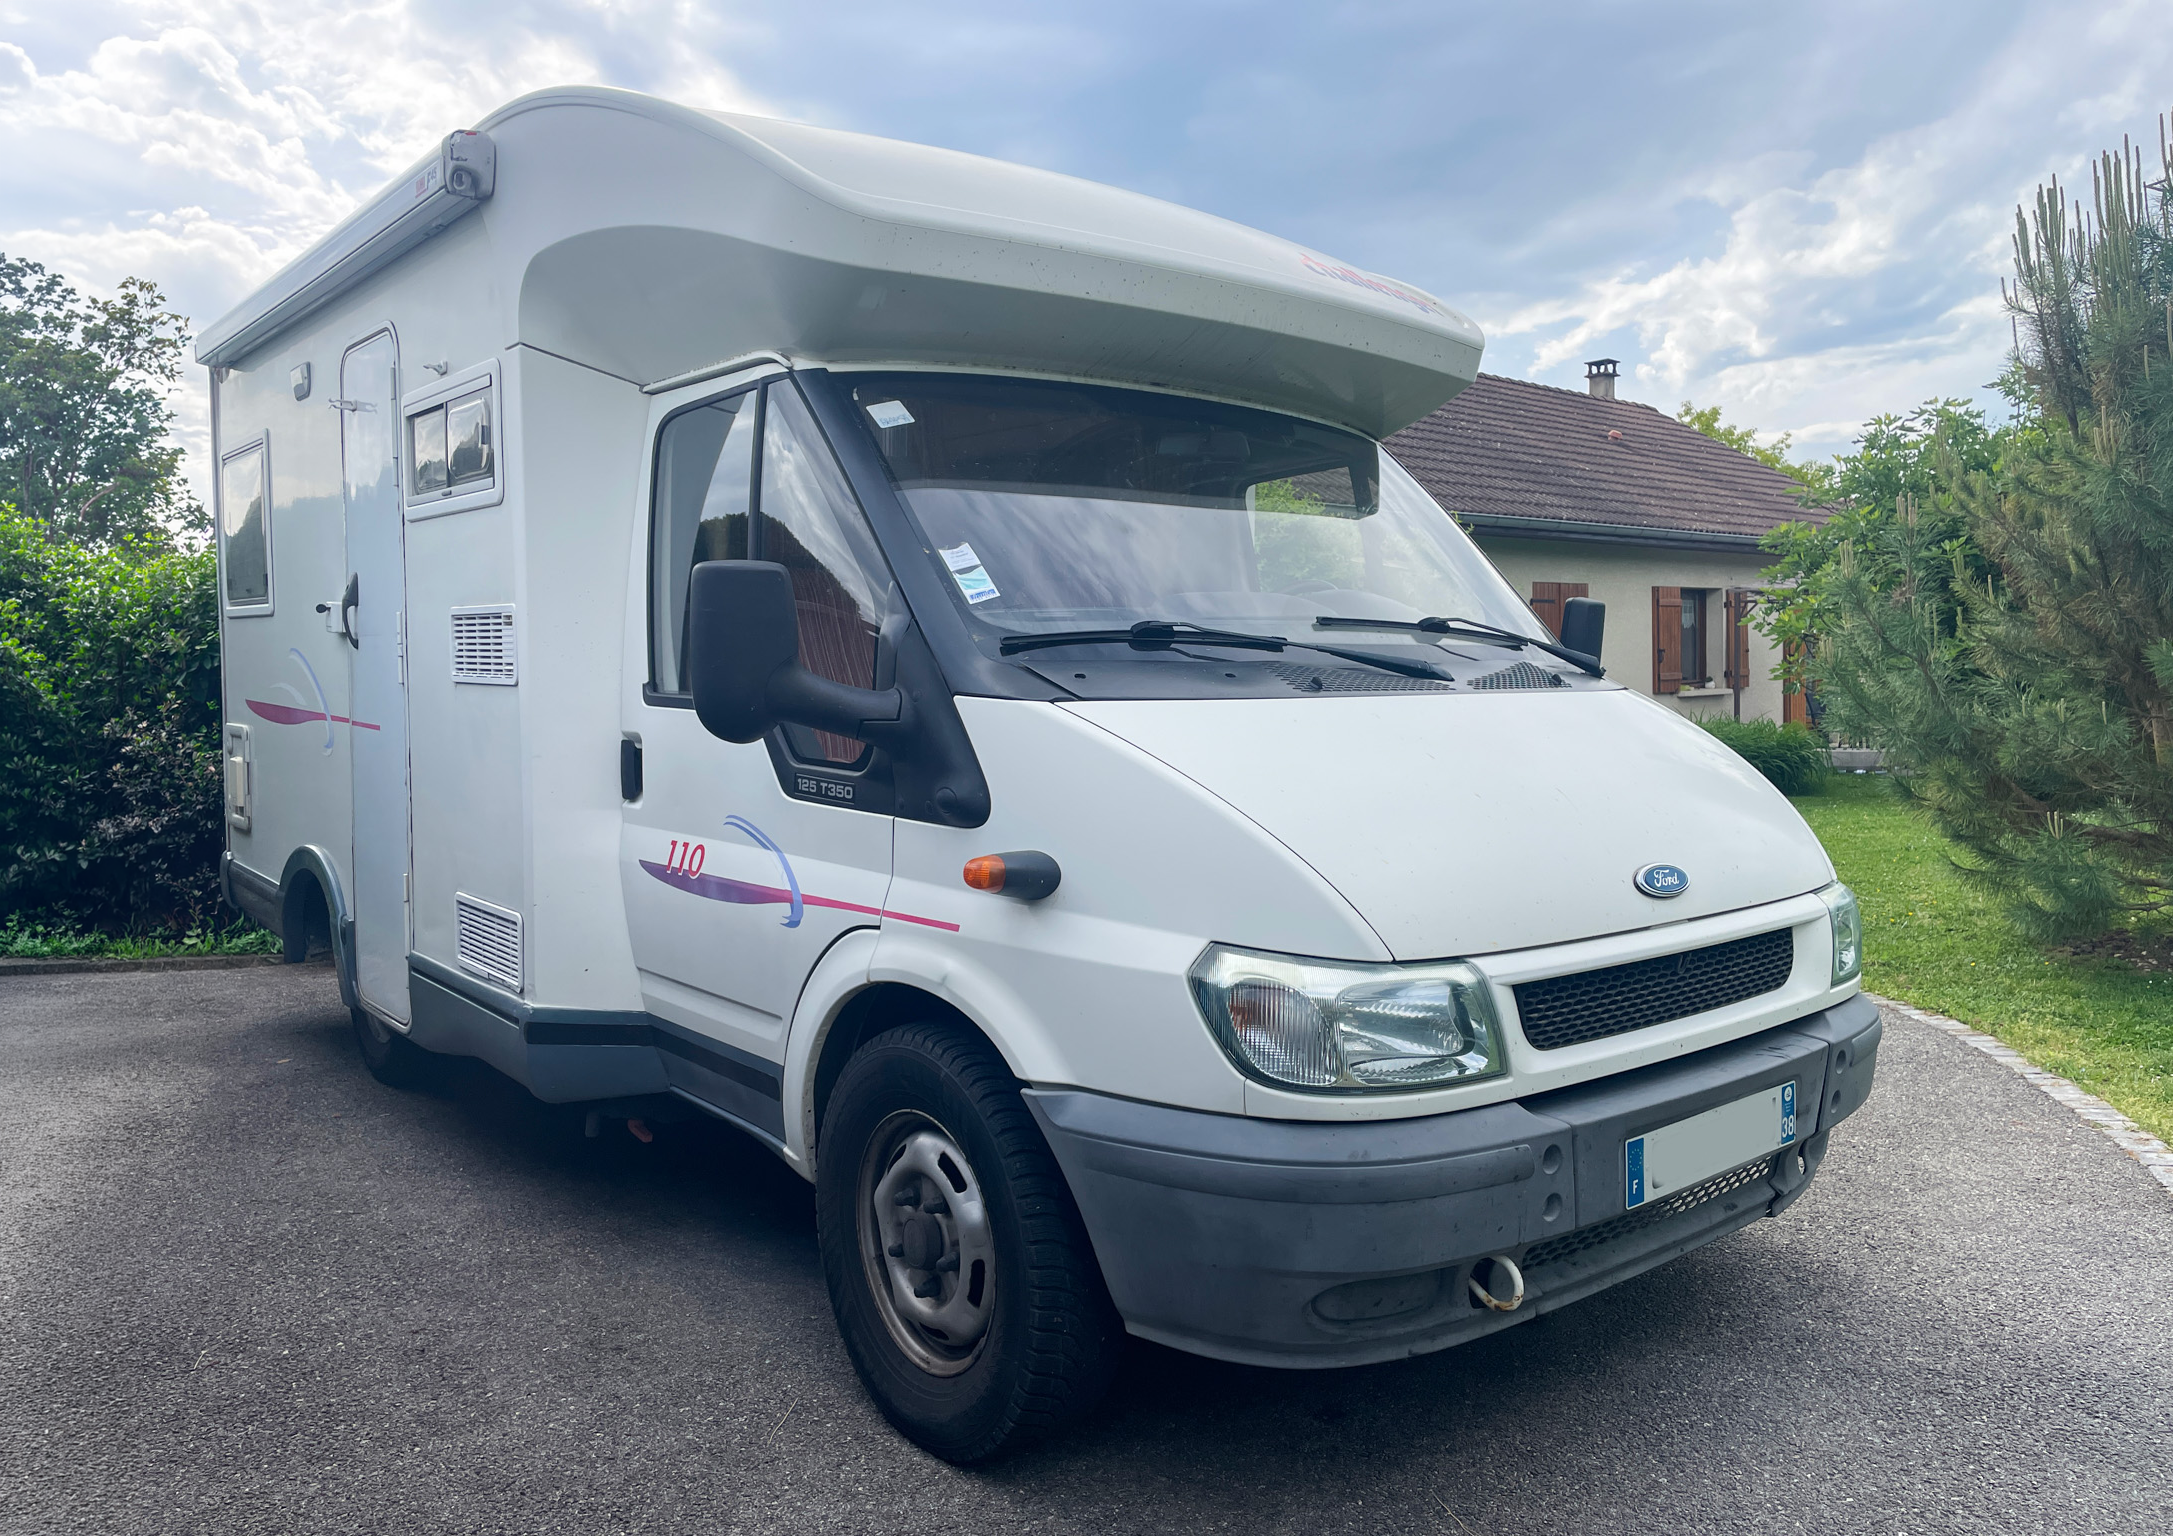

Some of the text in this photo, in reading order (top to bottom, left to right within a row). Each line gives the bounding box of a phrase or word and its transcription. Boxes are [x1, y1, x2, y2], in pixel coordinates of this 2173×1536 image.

[797, 778, 853, 799] 125 T350
[666, 839, 706, 880] 110
[1653, 869, 1680, 888] Ford
[1782, 1114, 1795, 1138] 38
[1632, 1179, 1639, 1195] F
